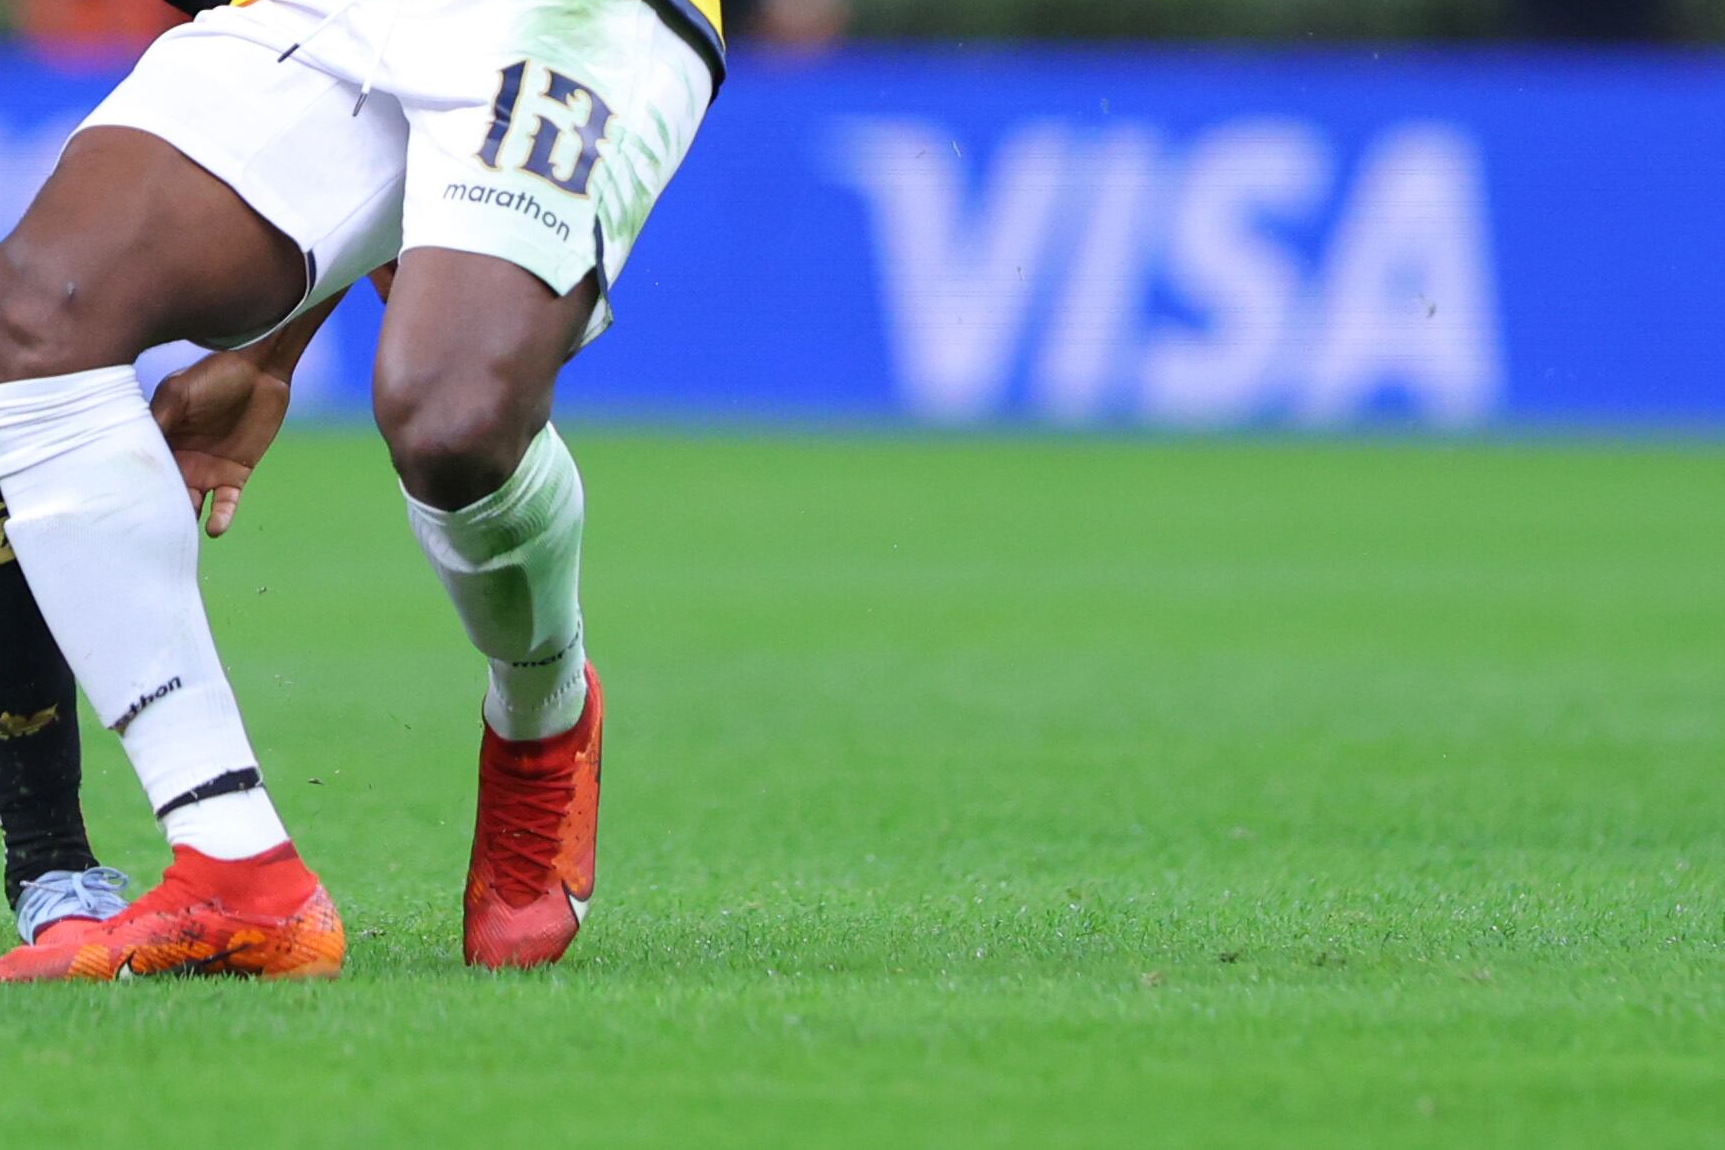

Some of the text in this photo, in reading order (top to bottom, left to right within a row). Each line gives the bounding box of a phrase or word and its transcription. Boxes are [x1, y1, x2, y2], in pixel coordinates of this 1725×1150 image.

[472, 56, 619, 200] 13
[442, 182, 572, 243] marathon
[820, 112, 1510, 425] VISA
